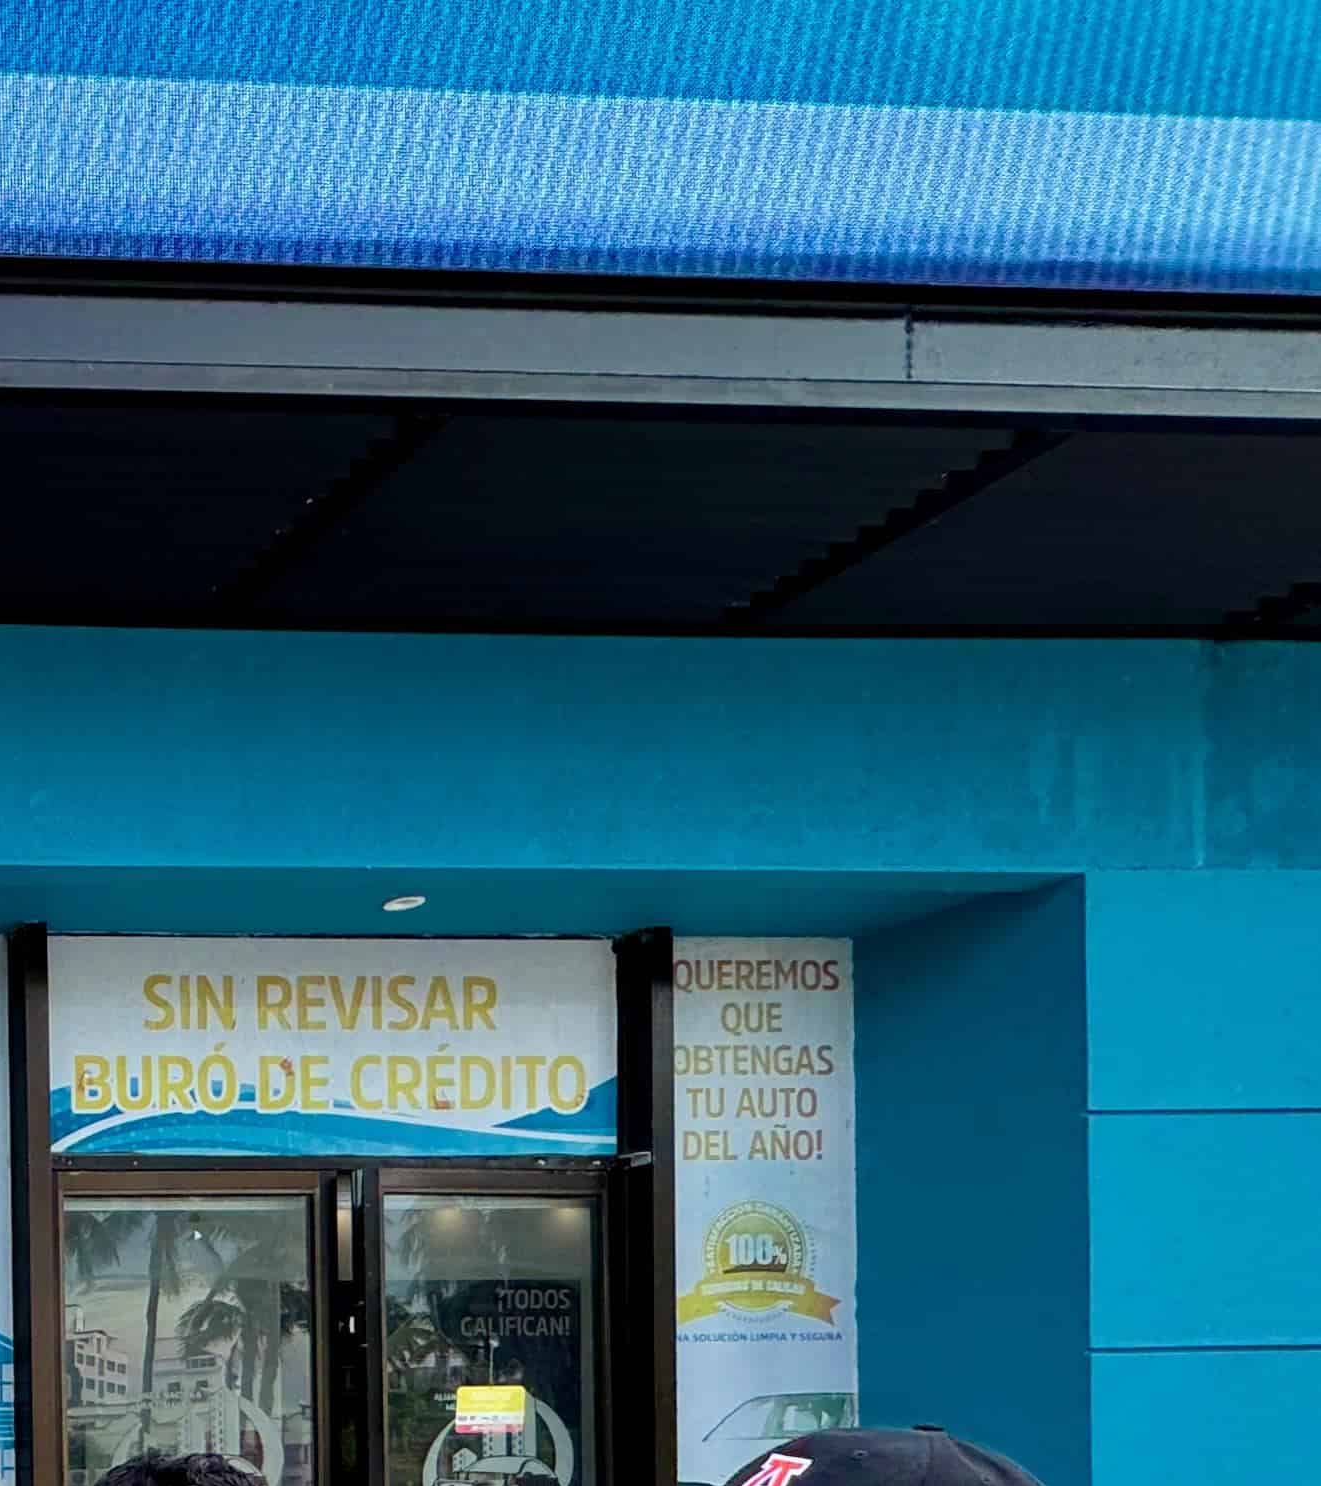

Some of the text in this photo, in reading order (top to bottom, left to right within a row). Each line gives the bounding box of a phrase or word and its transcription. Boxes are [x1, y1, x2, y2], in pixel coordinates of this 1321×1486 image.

[673, 959, 839, 992] QUEREMOS
[142, 975, 497, 1030] SIN REVISAR
[721, 1002, 782, 1036] QUE
[73, 1042, 586, 1110] BURÓ DE CRÉDITO
[674, 1045, 834, 1076] OBTENGAS
[686, 1087, 818, 1118] TU AUTO
[683, 1123, 823, 1160] DEL AÑO!
[726, 1233, 787, 1266] 100%
[460, 1316, 571, 1337] CALIFICAN!
